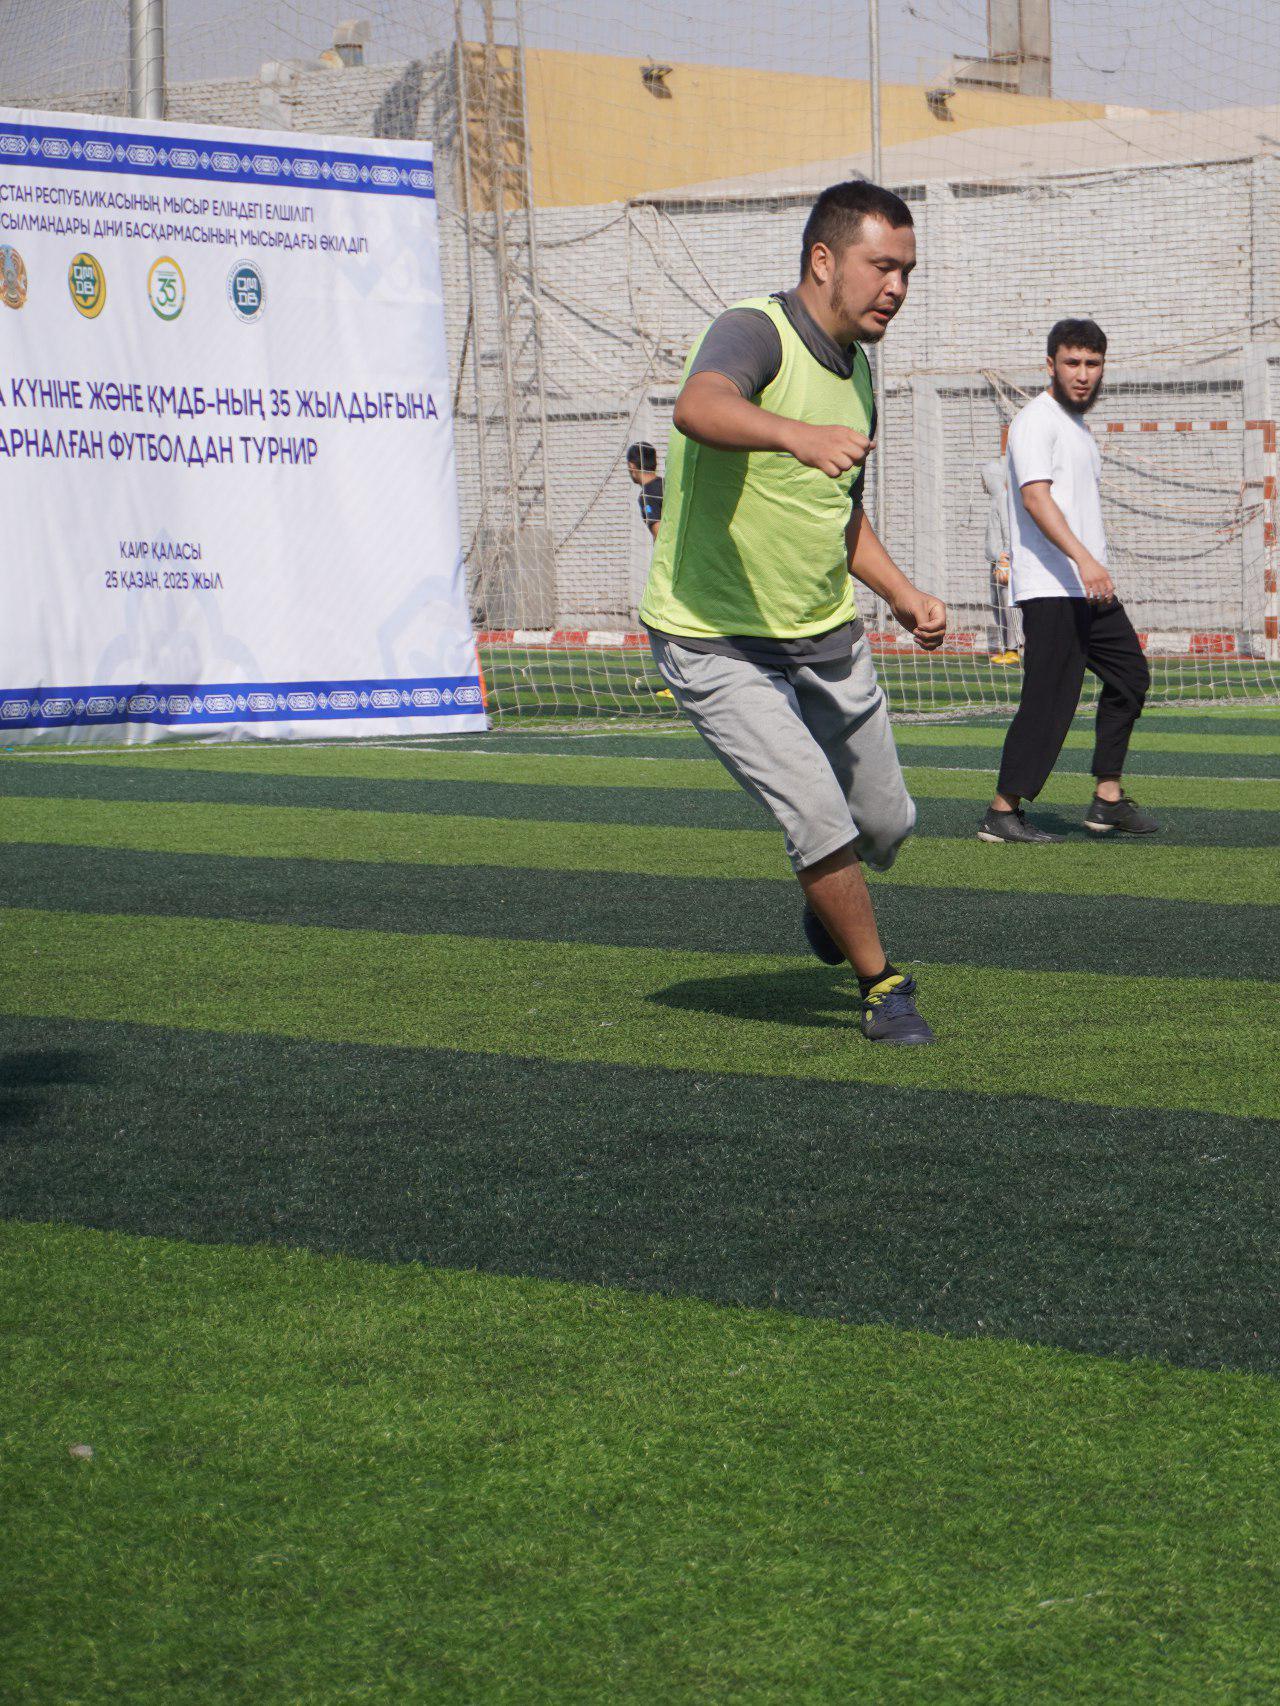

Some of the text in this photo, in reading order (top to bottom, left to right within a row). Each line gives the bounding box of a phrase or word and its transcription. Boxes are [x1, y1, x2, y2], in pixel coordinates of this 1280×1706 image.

[0, 184, 314, 223] СТАН РЕСПУБЛИКАСЫНЫҢ МЫСЫР ЕЛІНДЕГІ ЕЛШІЛІГІ
[0, 212, 369, 254] СЫЛМАНДАРЫ ДІНИ БАСҚАРМАСЫНЫҢ МЫСЫРДАҒЫ ӨКІЛДІГІ
[157, 278, 177, 307] 35
[11, 378, 83, 409] КҮНІНЕ
[86, 381, 144, 412] ЖӘНЕ
[147, 384, 266, 421] ҚМДБ-НЫҢ
[270, 388, 291, 417] 35
[295, 390, 439, 423] ЖЫЛДЫҒЫНА
[0, 428, 318, 468] АРНАЛҒАН ФУТБОЛДАН ТУРНИР
[119, 541, 202, 561] КАИР ҚАЛАСЫ
[105, 571, 224, 591] 25 ҚАЗАН, 2025 ЖЫЛ
